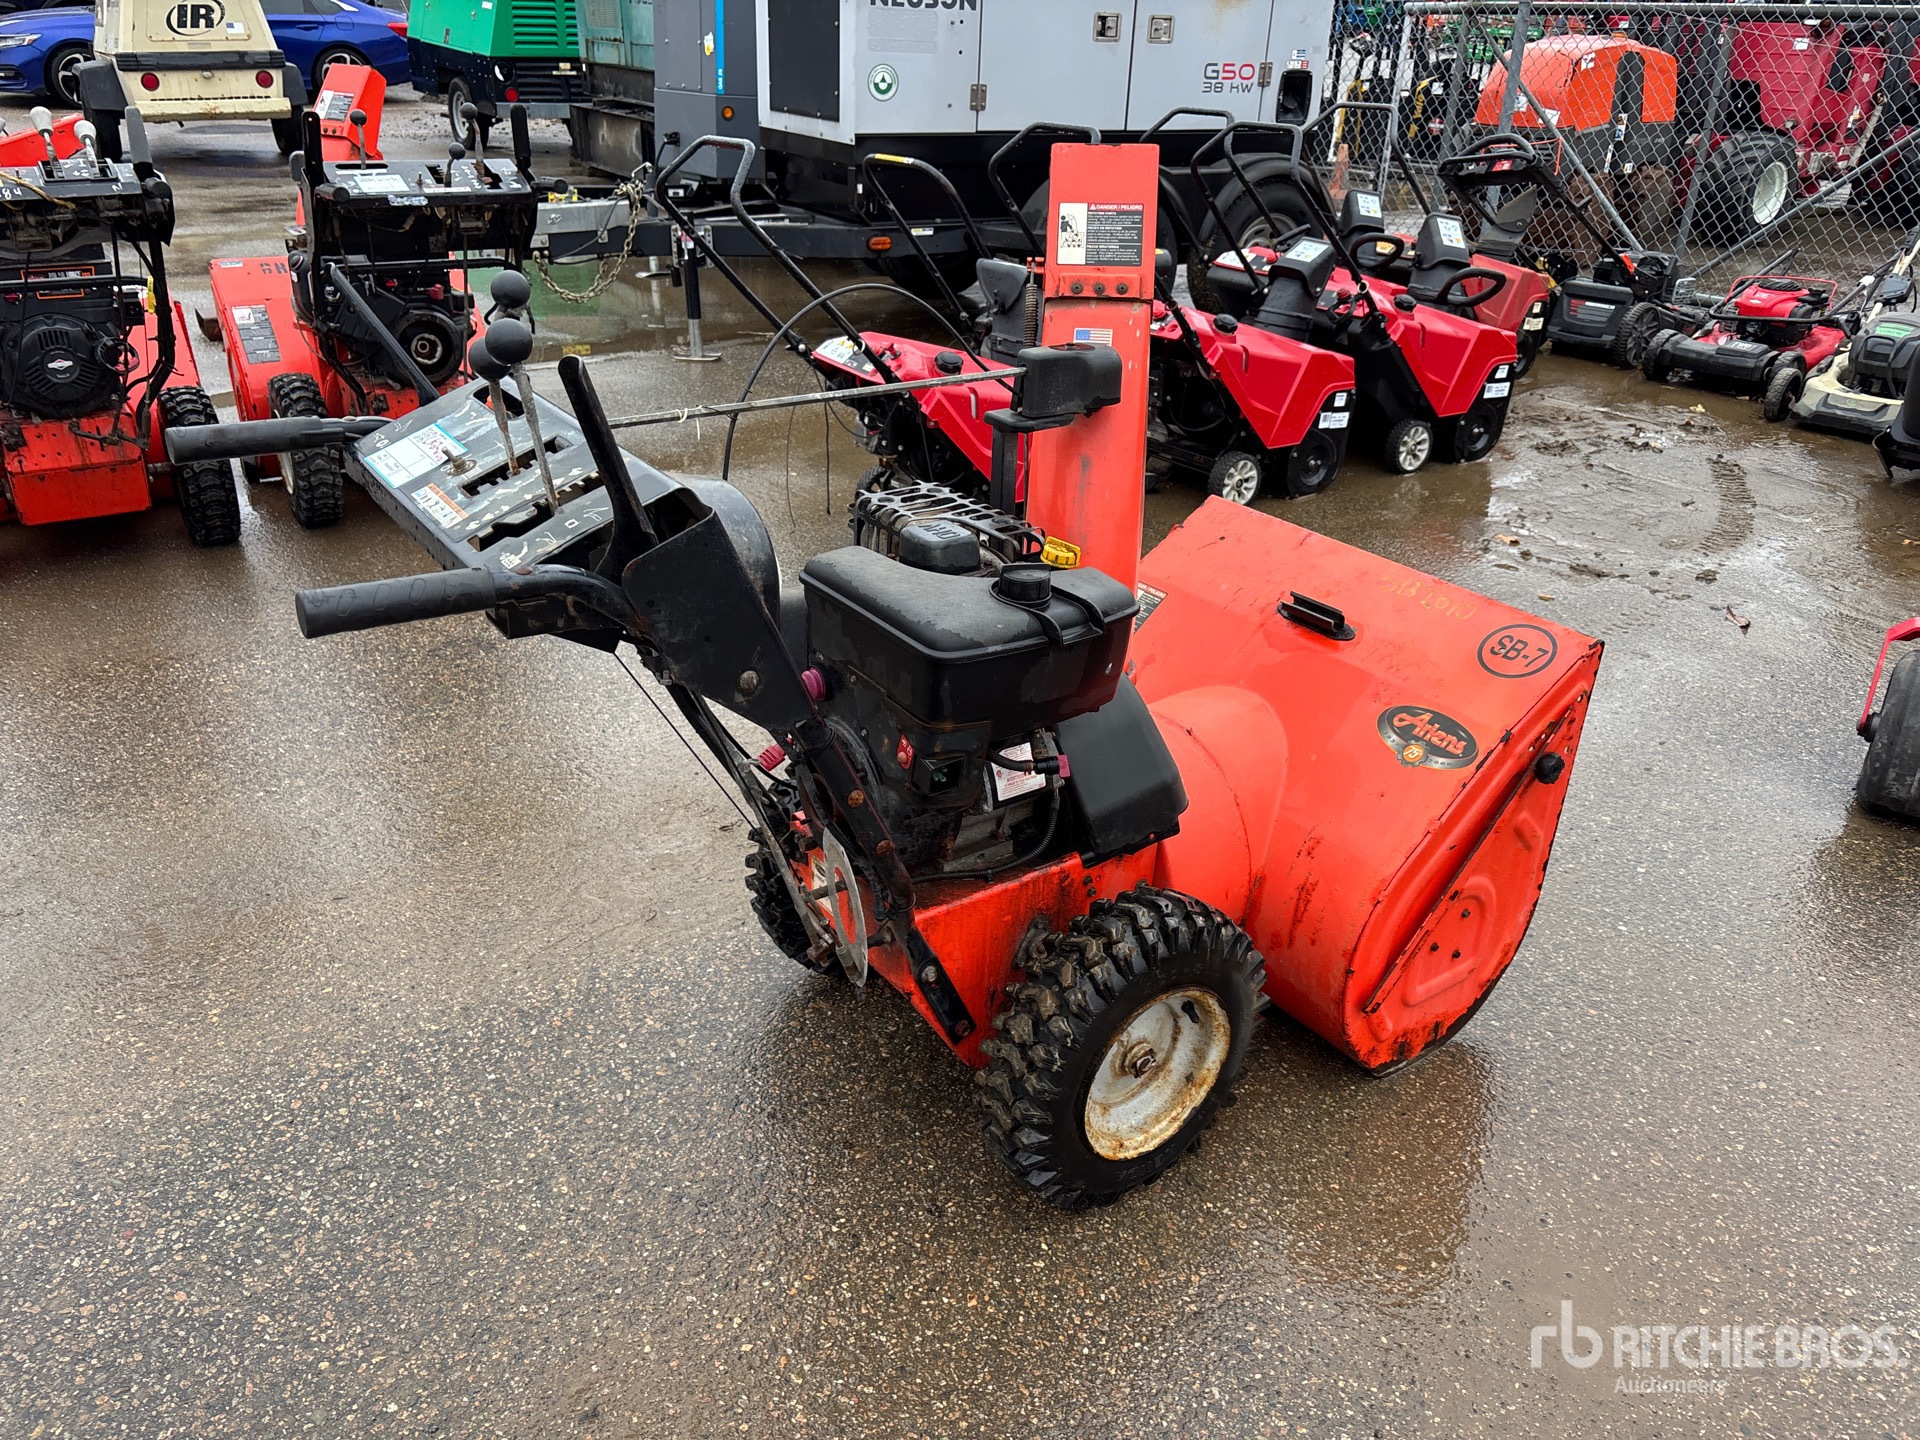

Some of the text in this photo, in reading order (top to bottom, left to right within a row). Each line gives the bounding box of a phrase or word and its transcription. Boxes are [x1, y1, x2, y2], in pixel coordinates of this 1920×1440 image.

[177, 4, 215, 28] IR
[1204, 63, 1256, 81] G50
[1202, 82, 1224, 93] 38
[1490, 634, 1549, 667] SB-7
[1393, 712, 1467, 755] Ariens
